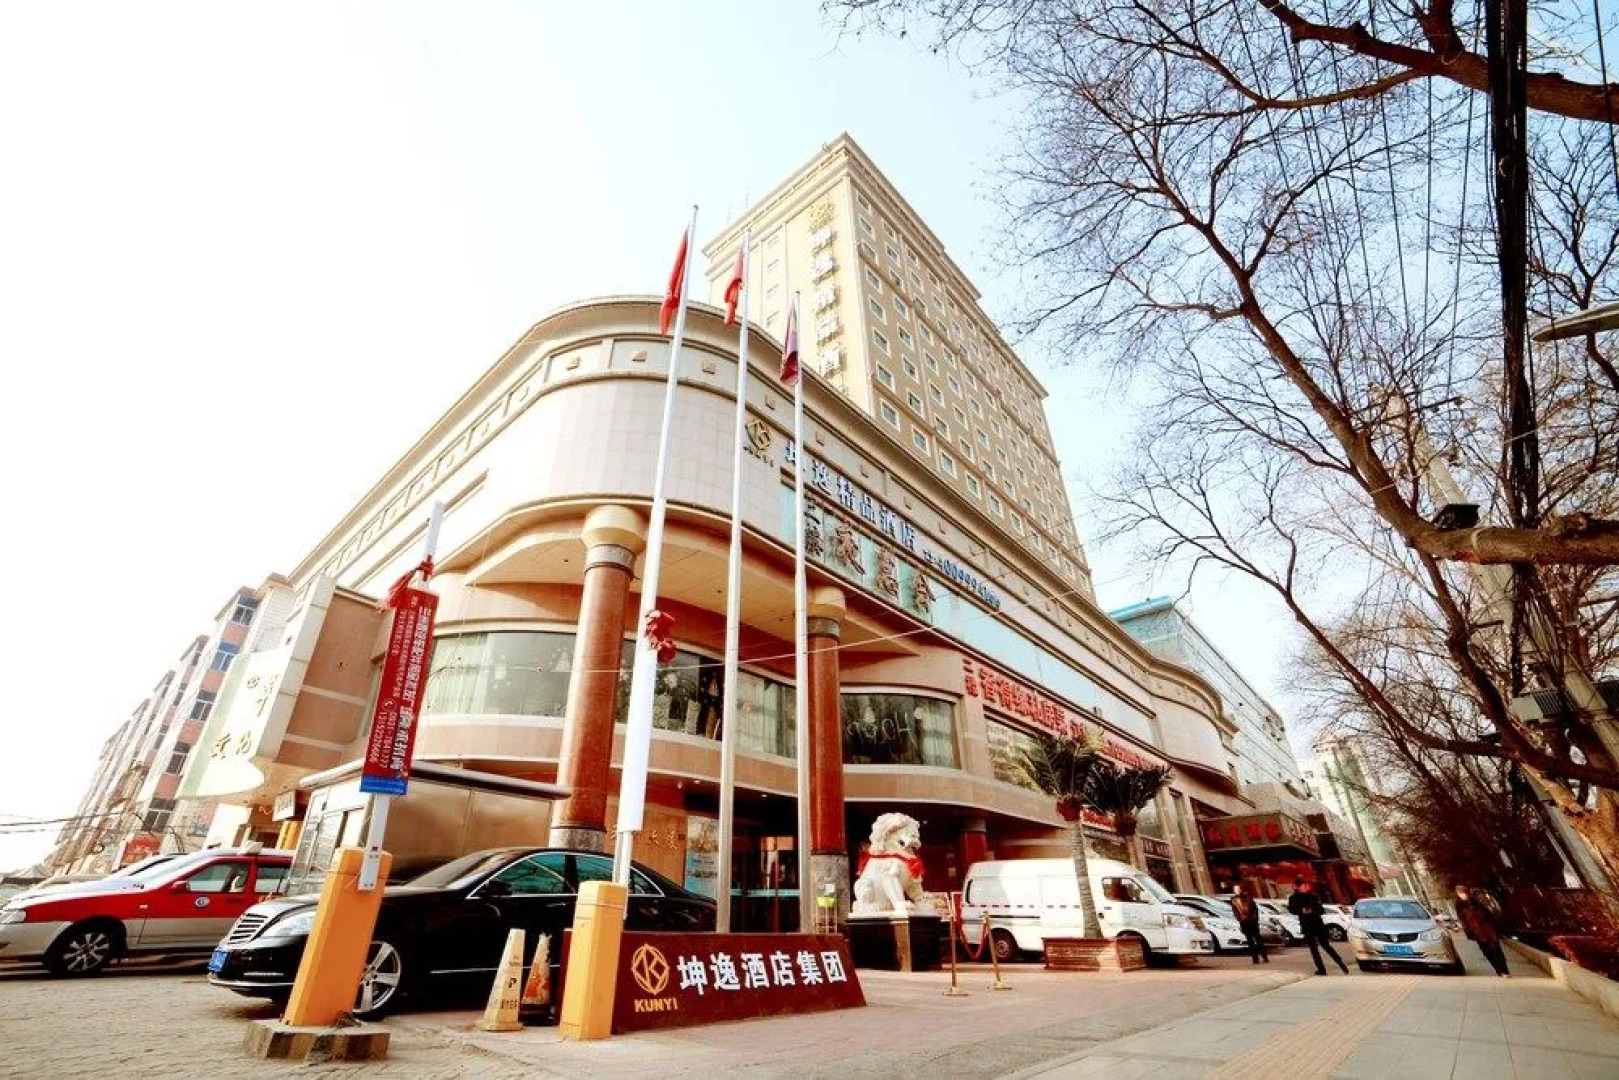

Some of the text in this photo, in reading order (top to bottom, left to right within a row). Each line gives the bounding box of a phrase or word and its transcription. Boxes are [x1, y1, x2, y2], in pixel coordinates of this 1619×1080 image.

[676, 949, 848, 995] 坤逸酒店集团
[634, 998, 678, 1013] KUNYI
